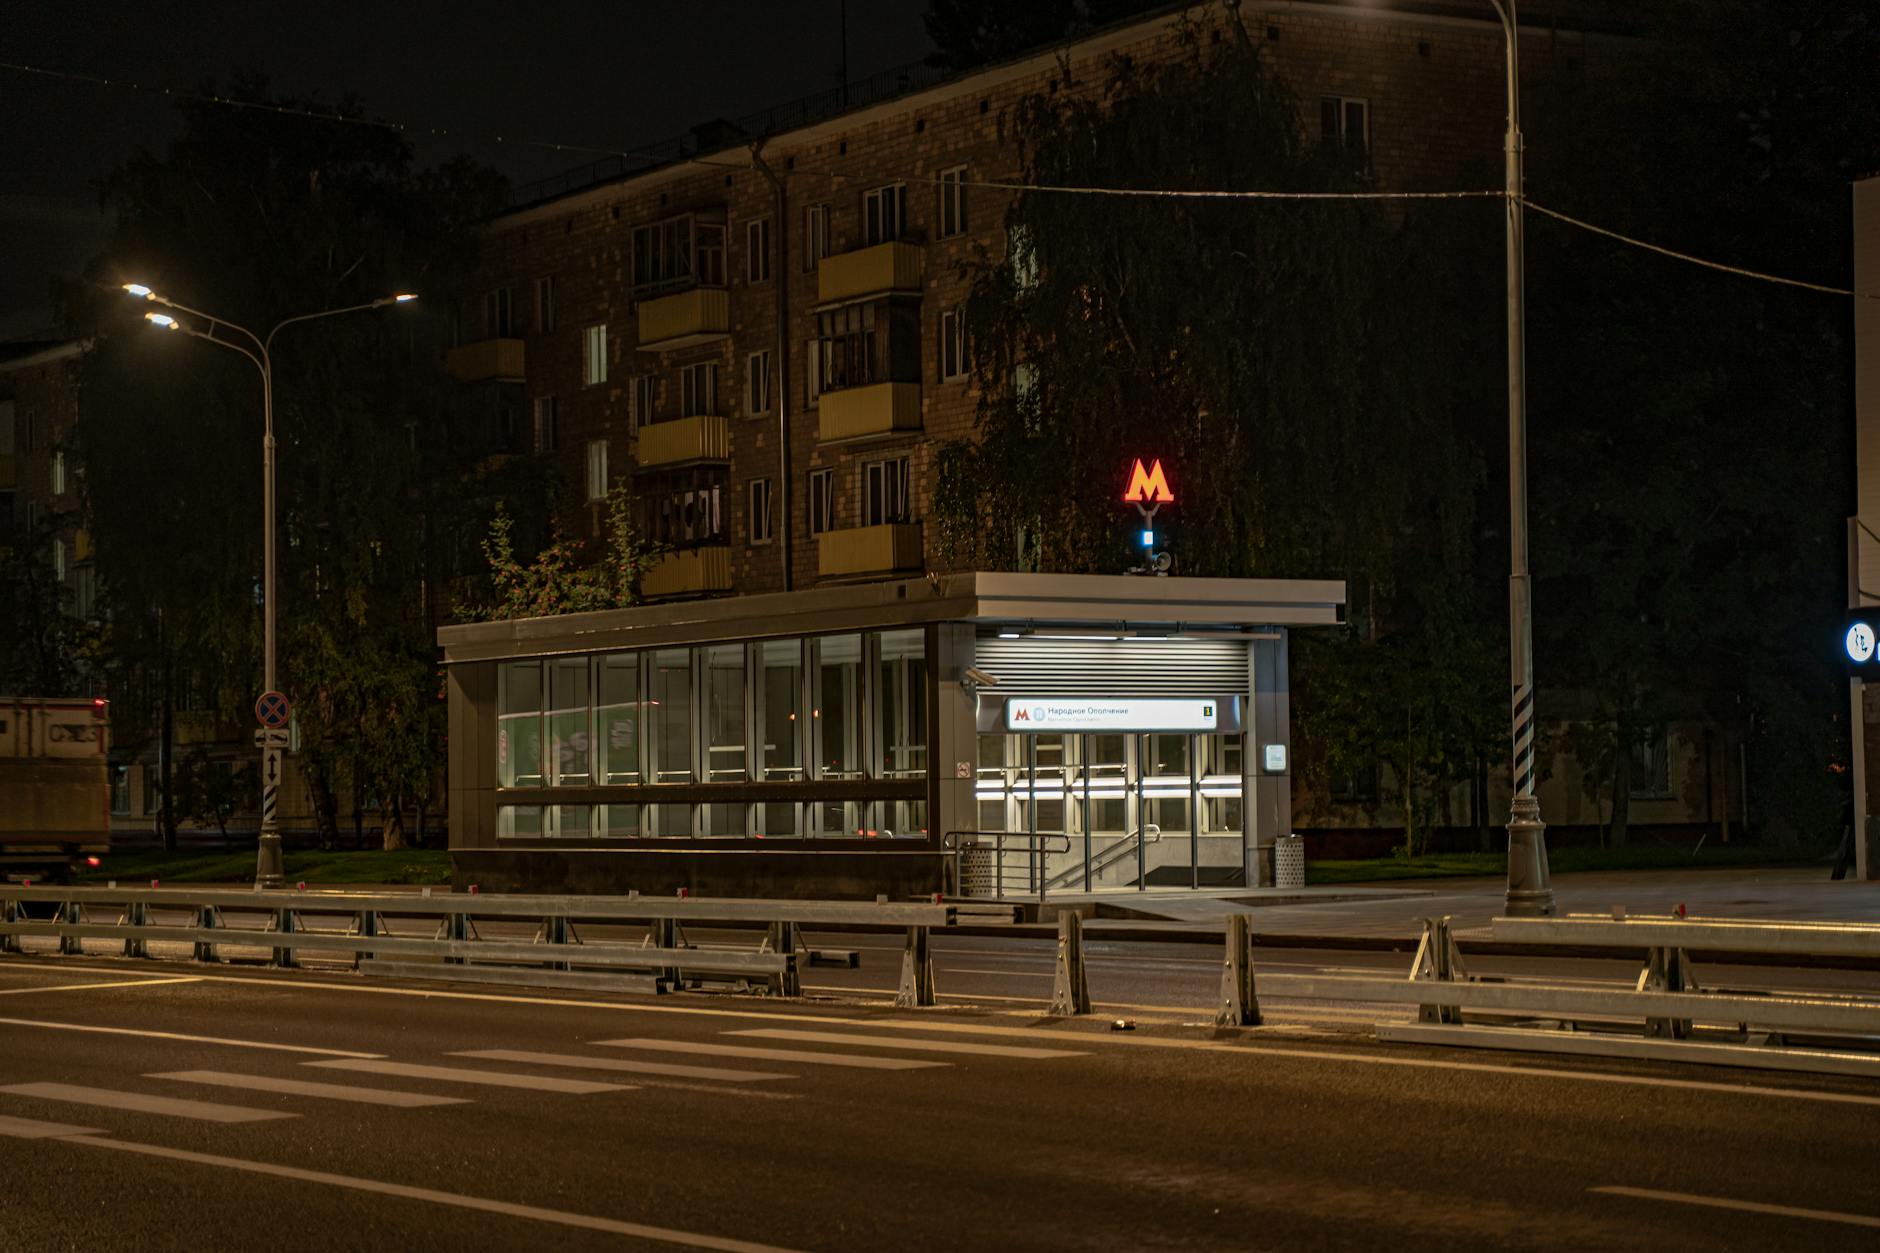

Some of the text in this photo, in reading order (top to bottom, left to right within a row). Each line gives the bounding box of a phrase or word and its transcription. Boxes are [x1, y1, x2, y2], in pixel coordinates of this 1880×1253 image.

[1124, 457, 1174, 501] М
[1015, 708, 1030, 721] М
[1047, 706, 1086, 716] Народное
[1087, 706, 1129, 715] Ополчение
